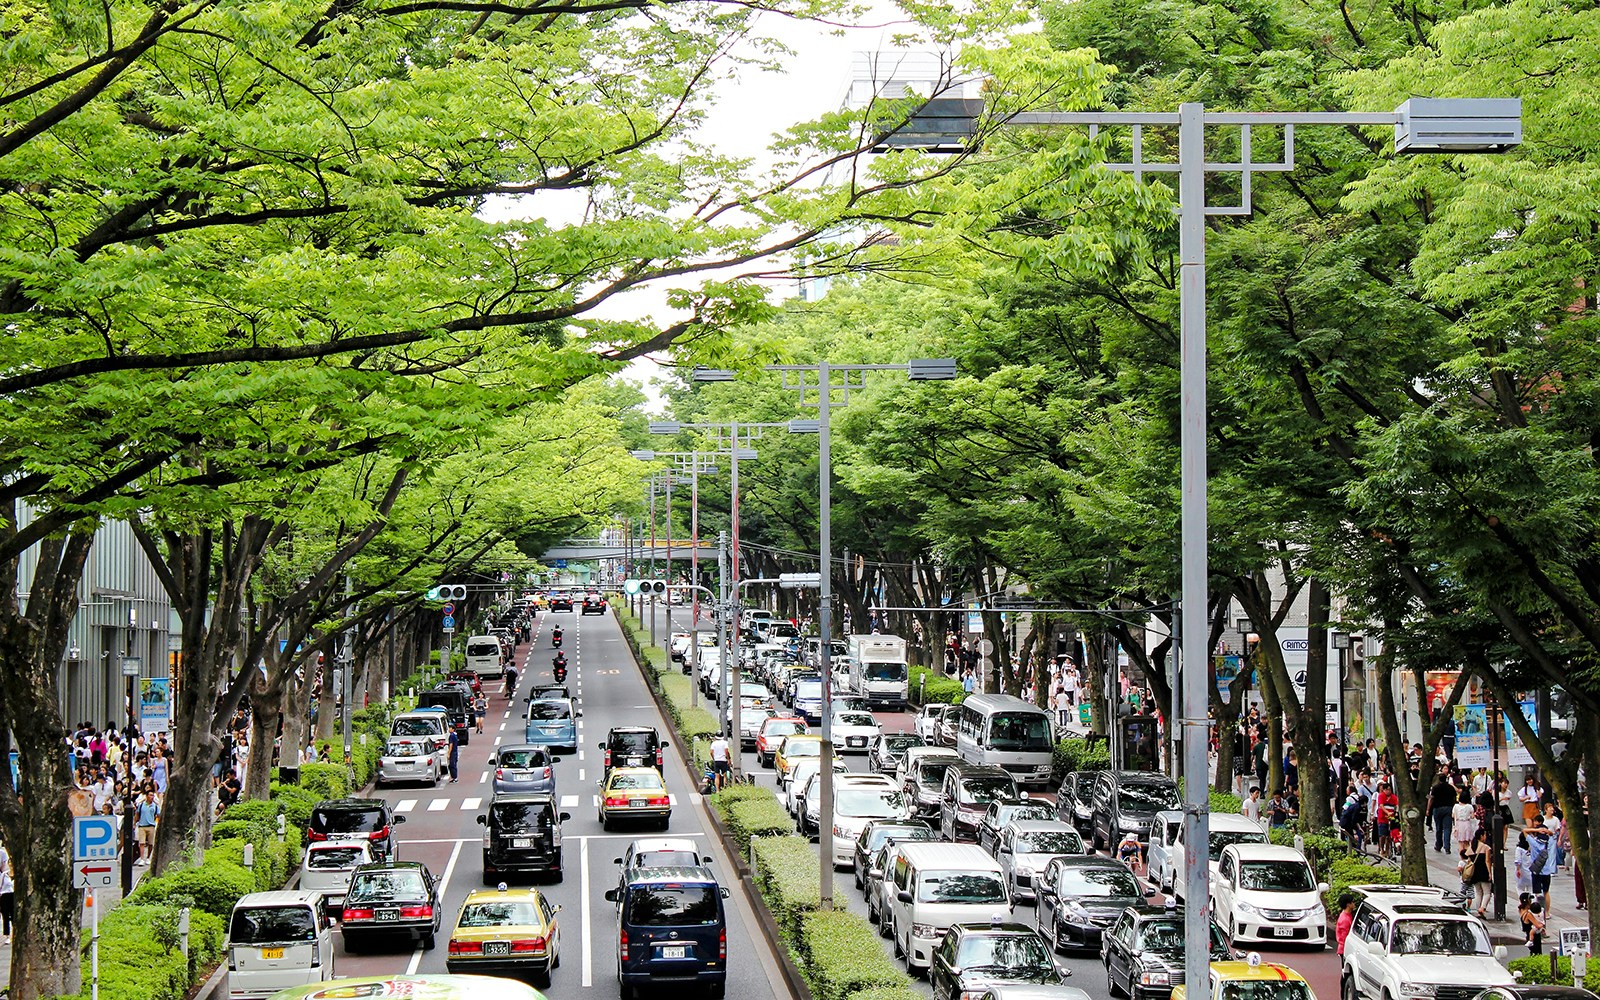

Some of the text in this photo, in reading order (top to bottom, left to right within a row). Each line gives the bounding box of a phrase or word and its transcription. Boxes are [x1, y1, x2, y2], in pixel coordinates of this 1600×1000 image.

[1287, 641, 1308, 649] RIMO
[79, 820, 112, 857] P
[90, 847, 115, 857] 駐車場
